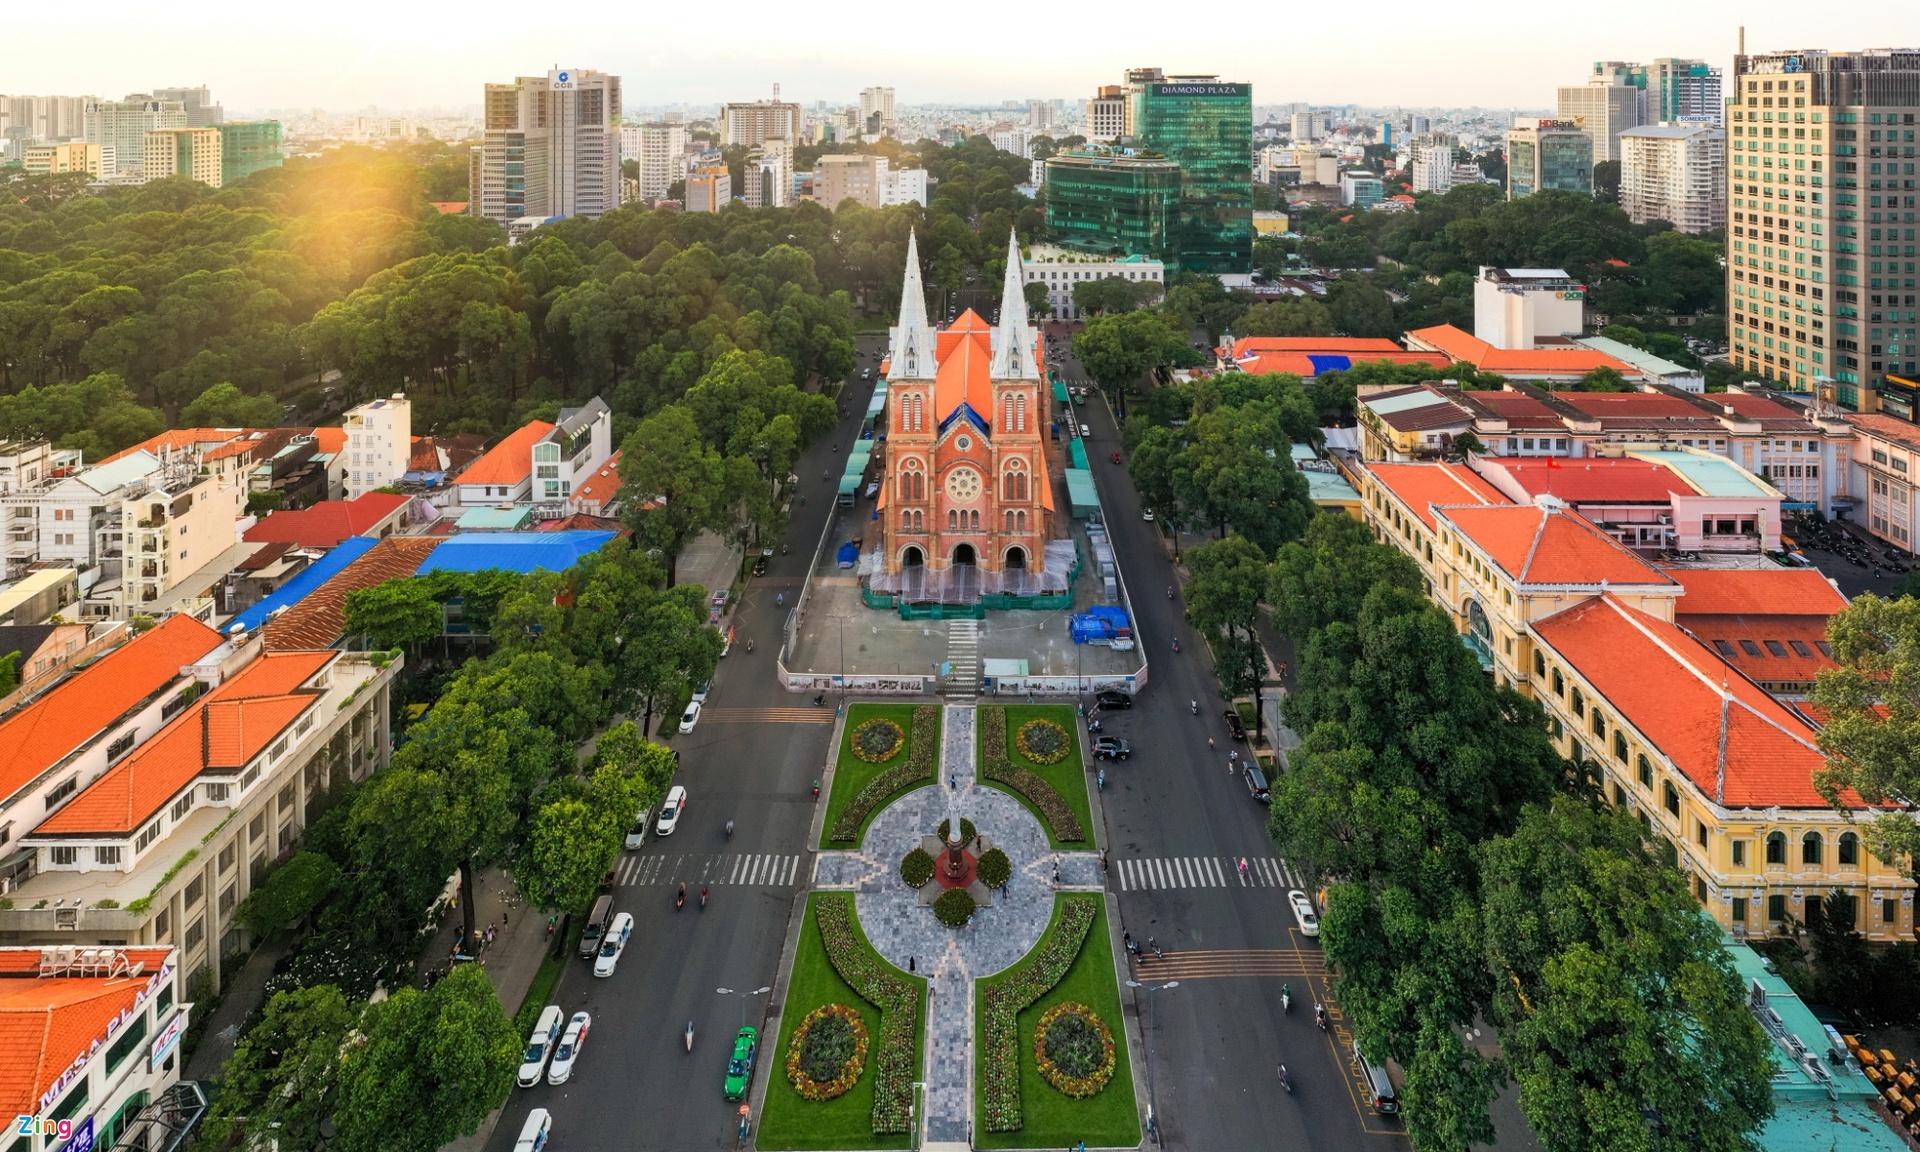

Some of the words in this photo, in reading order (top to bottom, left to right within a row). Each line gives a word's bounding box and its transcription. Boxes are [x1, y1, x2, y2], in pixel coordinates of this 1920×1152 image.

[1752, 61, 1785, 74] ANZ
[1161, 86, 1205, 94] DIAMOND
[1207, 86, 1236, 94] PLAZA
[1538, 119, 1575, 128] HDBank
[1321, 993, 1344, 1021] OFF
[38, 1038, 102, 1111] MESA
[106, 963, 172, 1040] PLAZA
